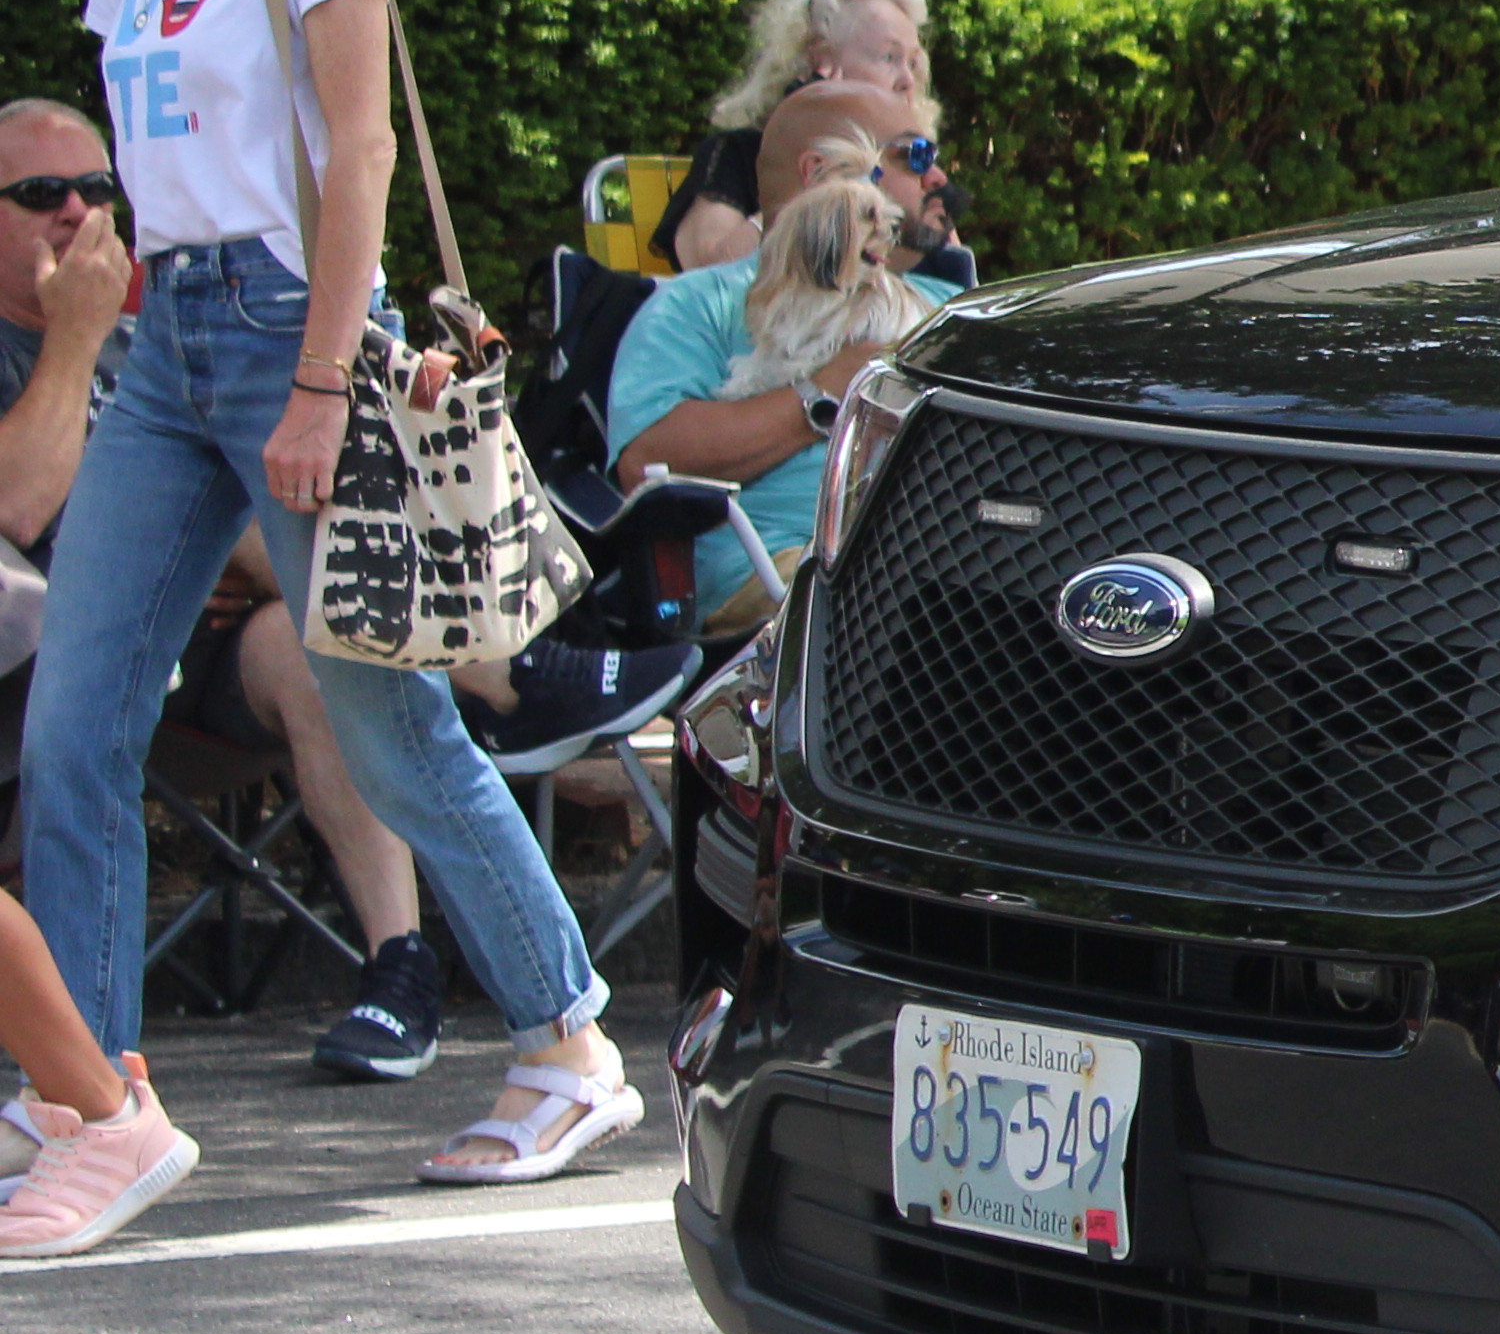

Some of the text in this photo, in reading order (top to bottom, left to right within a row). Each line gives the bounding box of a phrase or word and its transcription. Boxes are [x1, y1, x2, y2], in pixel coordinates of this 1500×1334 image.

[1080, 580, 1153, 635] Ford
[952, 1021, 1084, 1075] Rhode Island
[911, 1065, 1111, 1193] 835-549
[958, 1182, 1068, 1236] Ocean State
